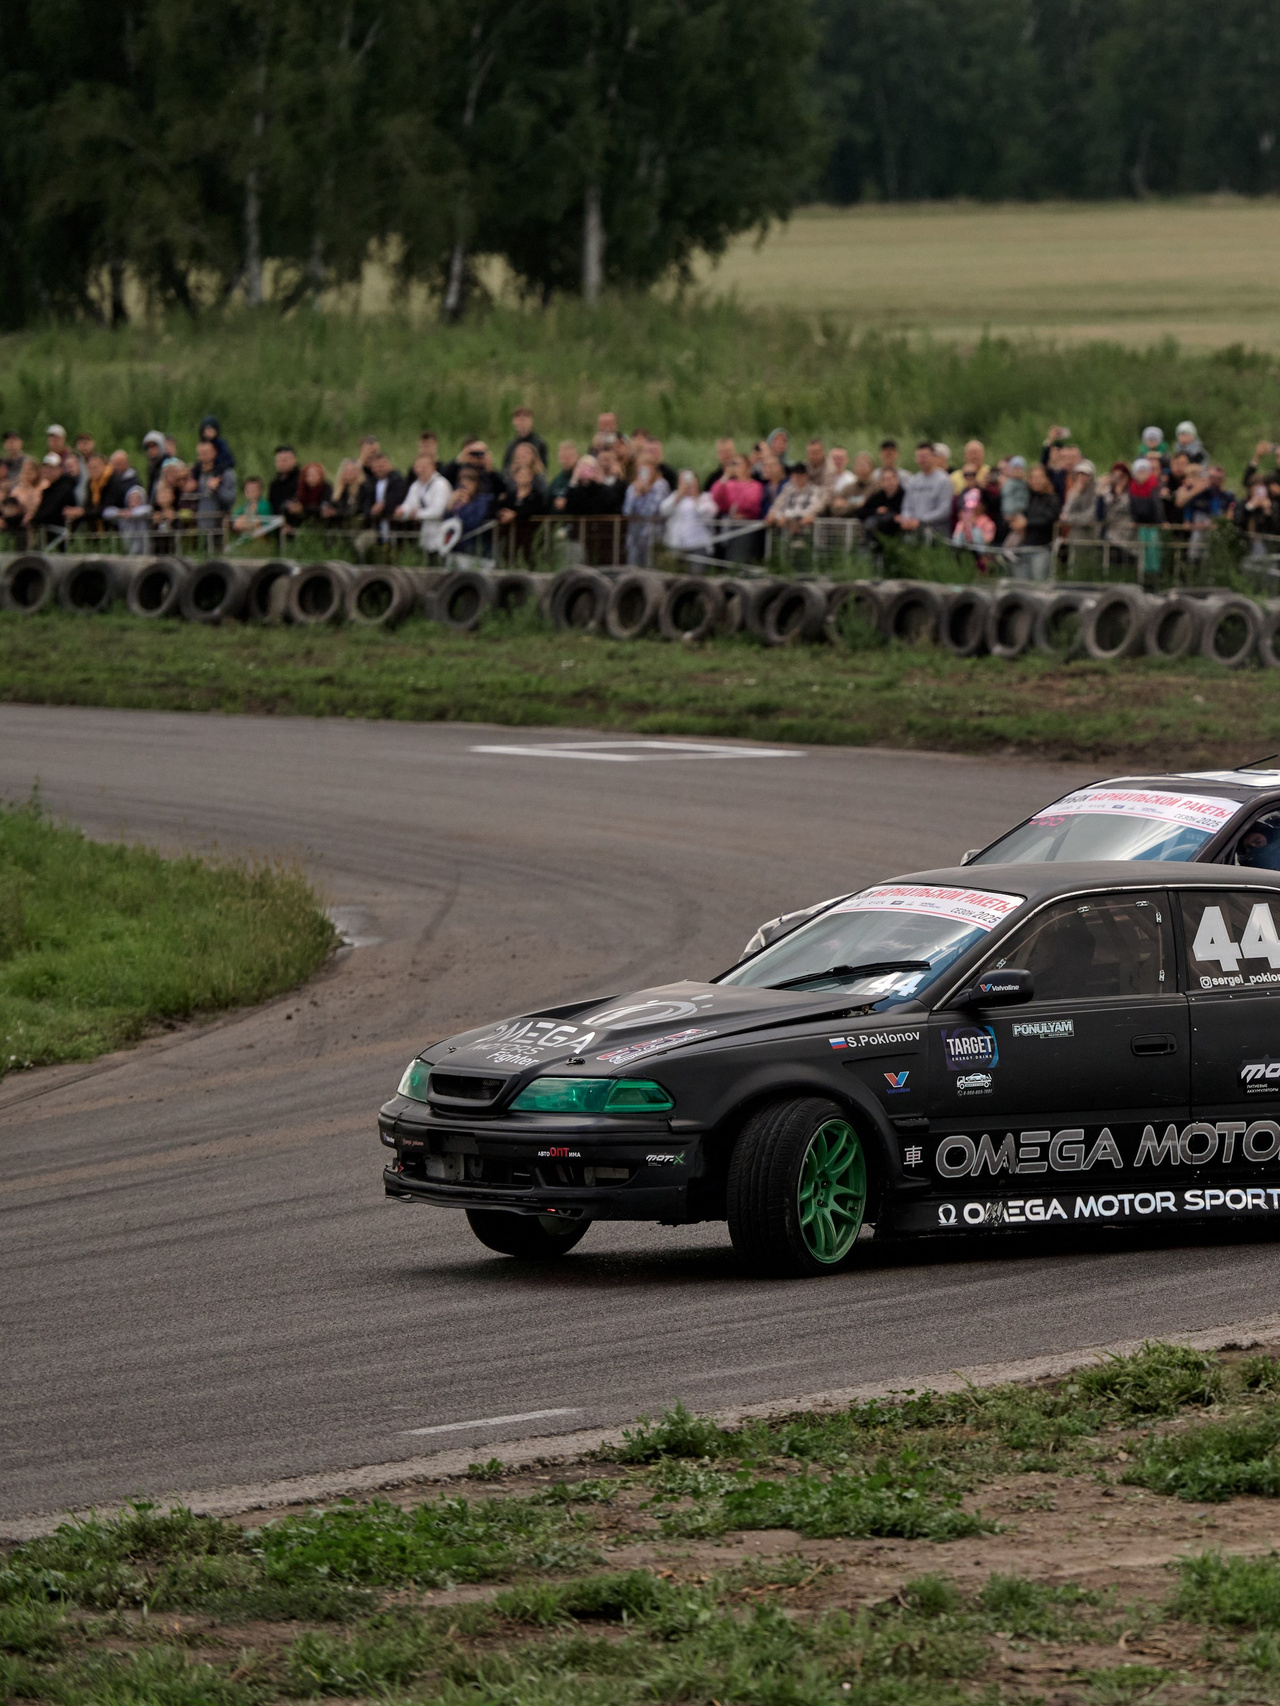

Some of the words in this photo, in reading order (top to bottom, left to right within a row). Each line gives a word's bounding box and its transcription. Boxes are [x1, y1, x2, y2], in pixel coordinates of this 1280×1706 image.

[1177, 800, 1234, 819] РАКЕТЫ
[1195, 817, 1222, 828] 2025
[963, 892, 1017, 915] РАКЕТЫ
[971, 911, 1002, 924] 2025
[868, 971, 926, 998] 44
[991, 984, 1020, 993] Valvoline
[1013, 1021, 1073, 1036] PONULYAM
[846, 1031, 920, 1048] S.Poklonov
[946, 1035, 993, 1056] TARGET
[486, 1051, 540, 1067] Fighter
[903, 1145, 924, 1168] 車
[936, 1127, 1123, 1179] OMEGA
[1074, 1190, 1177, 1219] MOTOR
